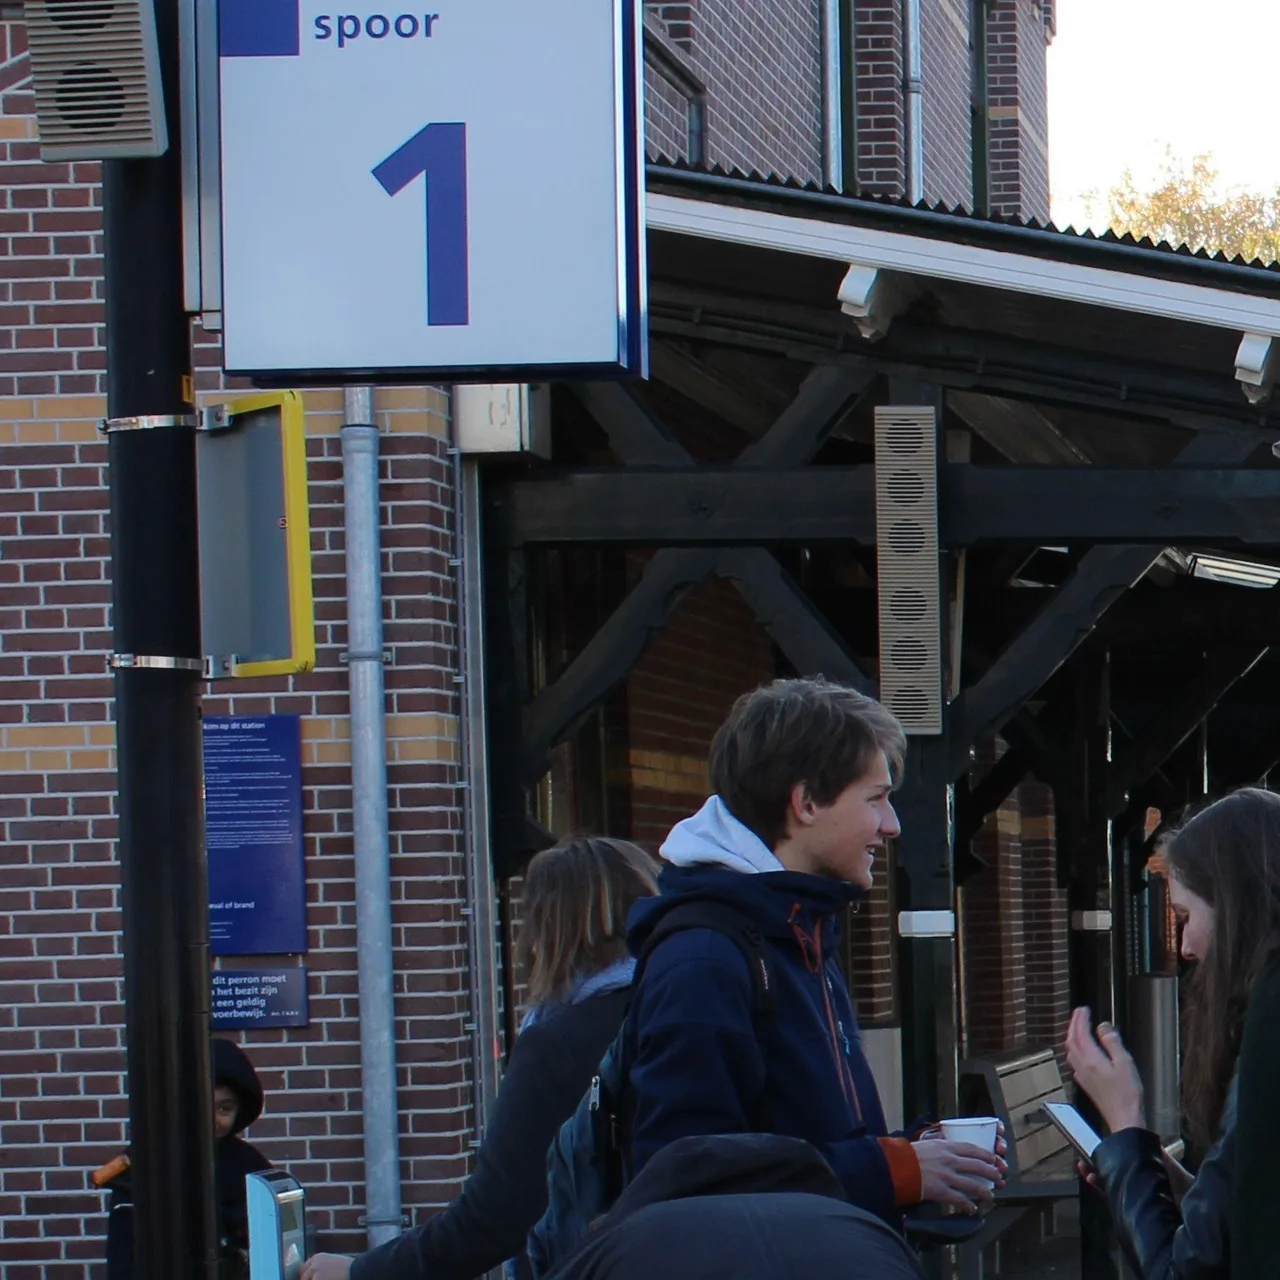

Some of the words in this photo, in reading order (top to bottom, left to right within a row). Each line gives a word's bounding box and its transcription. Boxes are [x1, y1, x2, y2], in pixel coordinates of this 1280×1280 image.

[314, 12, 440, 48] spoor
[371, 121, 469, 327] 1
[213, 976, 225, 984] dit
[228, 976, 259, 985] perron
[261, 975, 287, 983] moet
[217, 986, 232, 995] het
[235, 986, 258, 995] bezit
[260, 985, 278, 996] zijn
[216, 998, 234, 1006] een
[236, 997, 266, 1008] geldig
